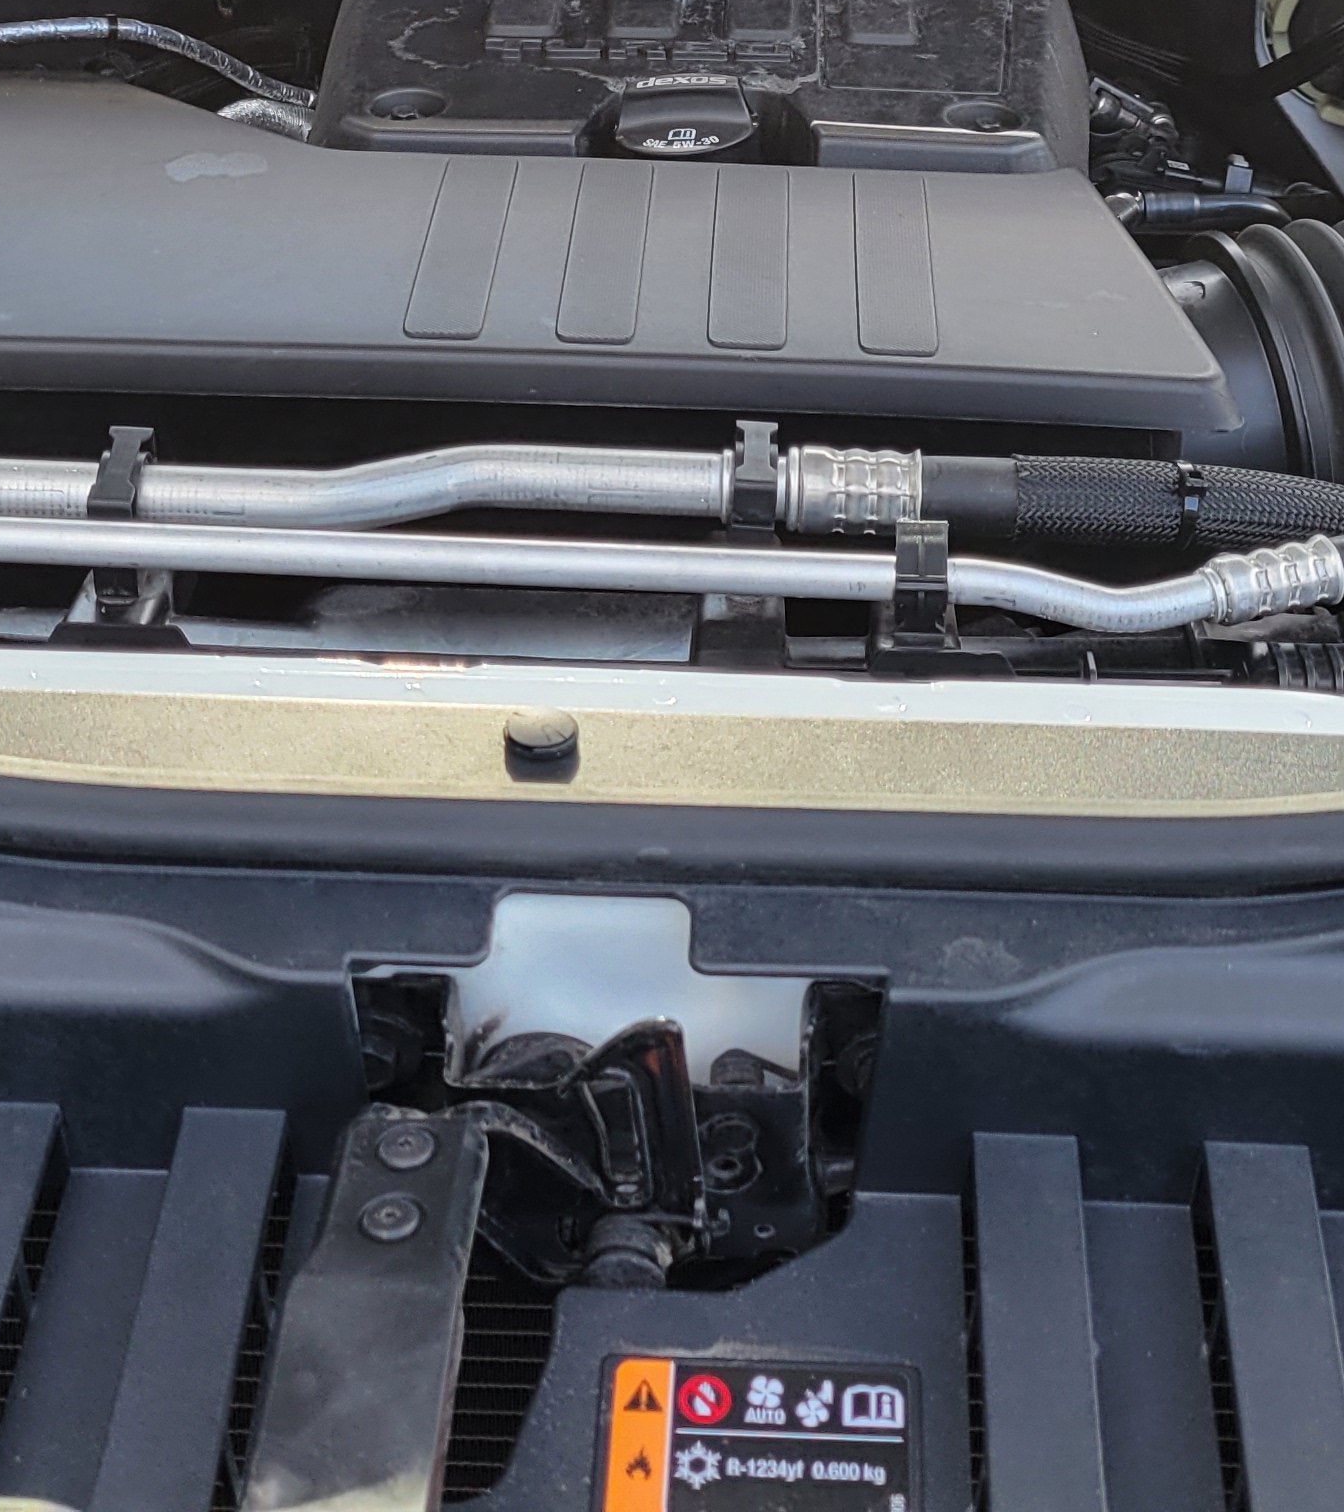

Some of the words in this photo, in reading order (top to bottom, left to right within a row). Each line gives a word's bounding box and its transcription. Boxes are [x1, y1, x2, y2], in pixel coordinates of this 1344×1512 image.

[636, 75, 728, 89] dexos
[642, 138, 668, 149] SAE
[672, 135, 720, 149] 5W-30
[743, 1407, 787, 1425] AUTO
[725, 1456, 805, 1483] R-1234yf
[811, 1459, 861, 1482] 0.600
[863, 1462, 887, 1486] kg
